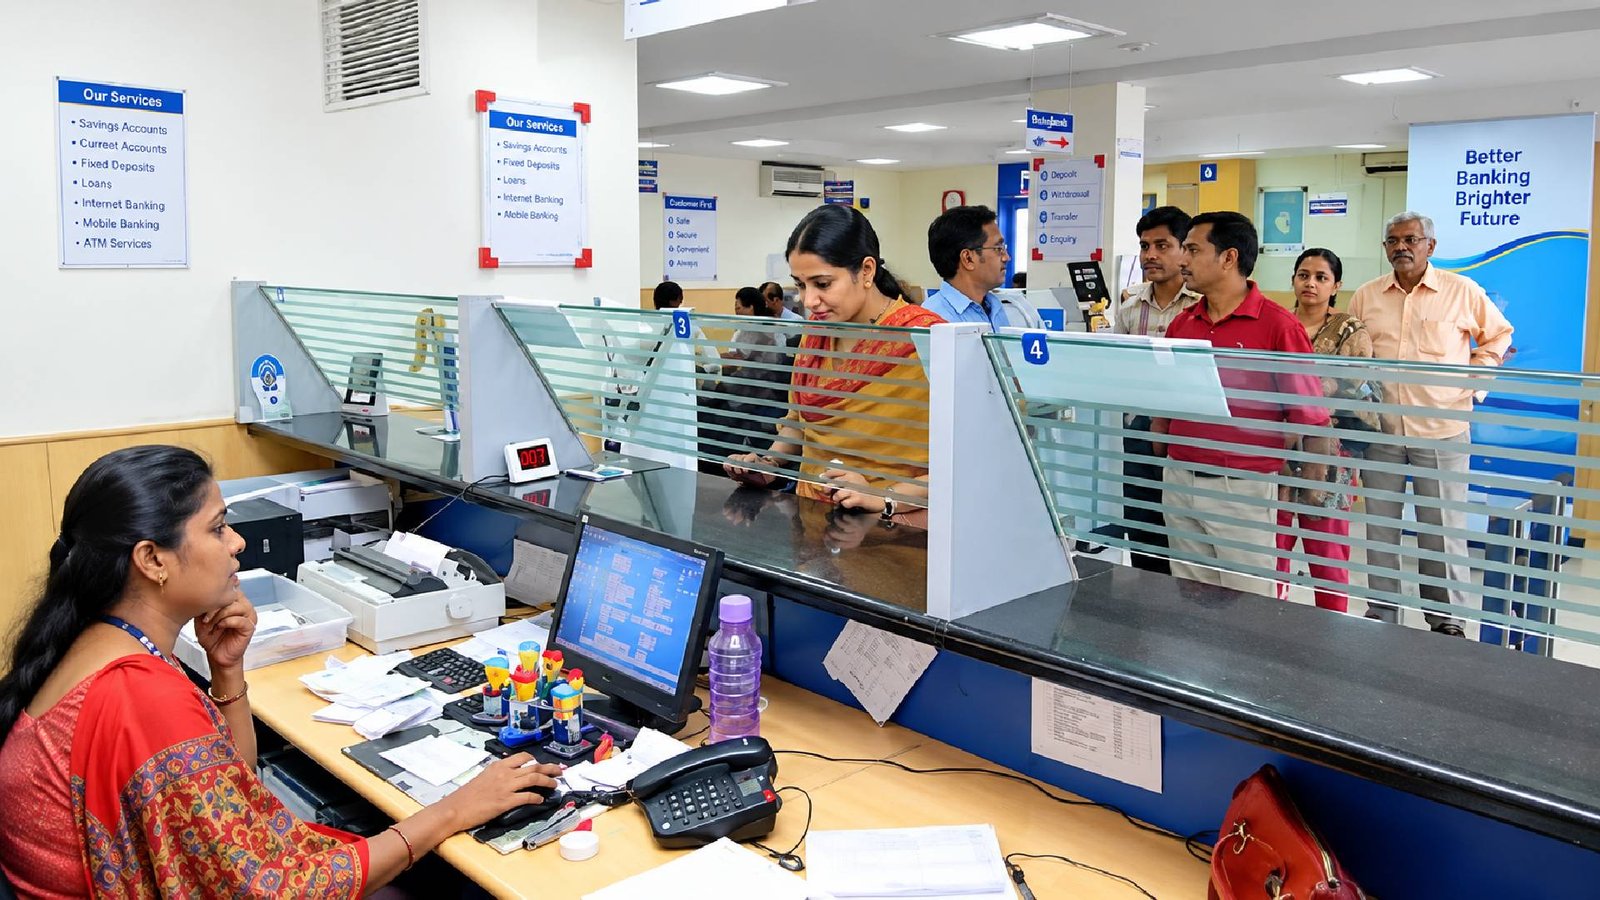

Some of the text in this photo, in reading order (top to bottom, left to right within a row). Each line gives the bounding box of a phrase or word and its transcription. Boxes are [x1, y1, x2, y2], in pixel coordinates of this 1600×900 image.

[83, 88, 162, 107] Our Services
[79, 118, 168, 135] Savings Accounts
[506, 116, 564, 133] Our Services
[121, 141, 167, 154] Accounts
[503, 141, 568, 155] Savings Accounts
[1465, 148, 1523, 165] Better
[81, 158, 155, 173] Fixed Deposits
[503, 158, 560, 171] Fixed Deposits
[82, 179, 112, 189] Loans
[503, 176, 526, 185] Loans
[1456, 167, 1531, 187] Banking
[82, 198, 165, 212] Internet Banking
[503, 193, 564, 206] Internet Banking
[1455, 189, 1531, 209] Brighter
[83, 218, 160, 231] Mobile Banking
[1460, 210, 1520, 226] Future
[676, 230, 698, 239] Secure
[83, 238, 152, 249] ATM Services
[678, 317, 686, 335] 3
[1029, 339, 1044, 359] 4
[520, 448, 545, 466] 007
